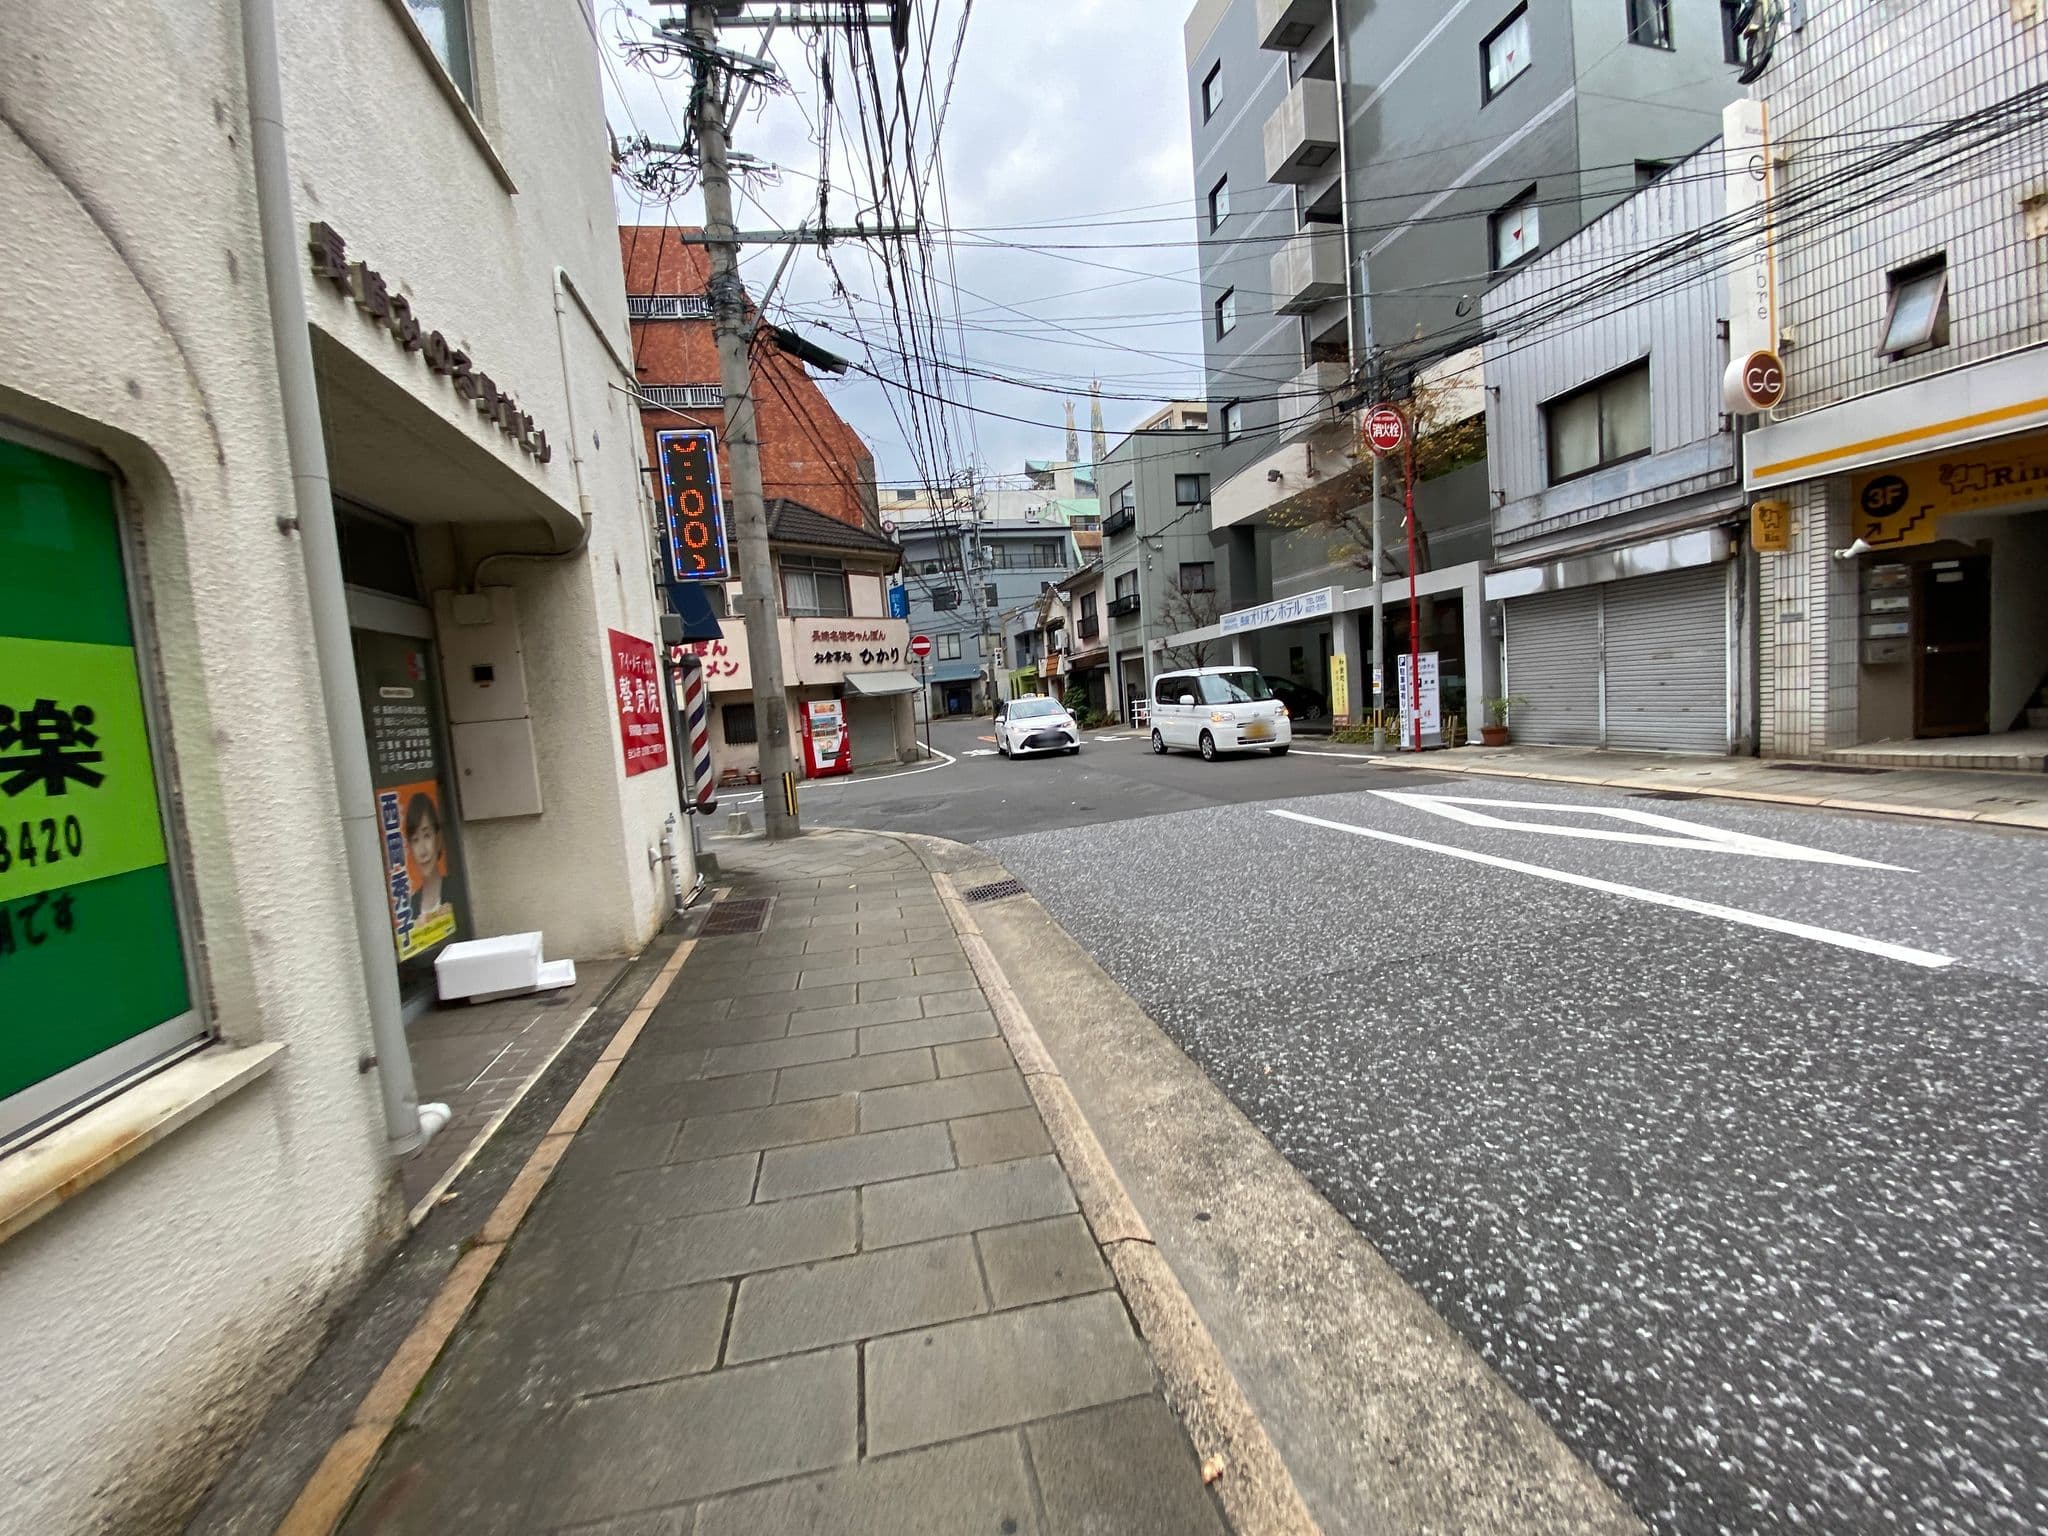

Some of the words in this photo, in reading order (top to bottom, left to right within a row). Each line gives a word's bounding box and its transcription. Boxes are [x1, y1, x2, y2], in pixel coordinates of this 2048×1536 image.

[1747, 367, 1781, 394] GG
[1372, 422, 1400, 438] 消火栓
[1868, 485, 1902, 509] 3F
[812, 630, 886, 642] 長崎名物ちゃんぽん
[814, 651, 852, 664] お食事処
[860, 648, 899, 665] ひかり
[618, 675, 660, 714] 整骨院
[0, 698, 105, 796] 楽
